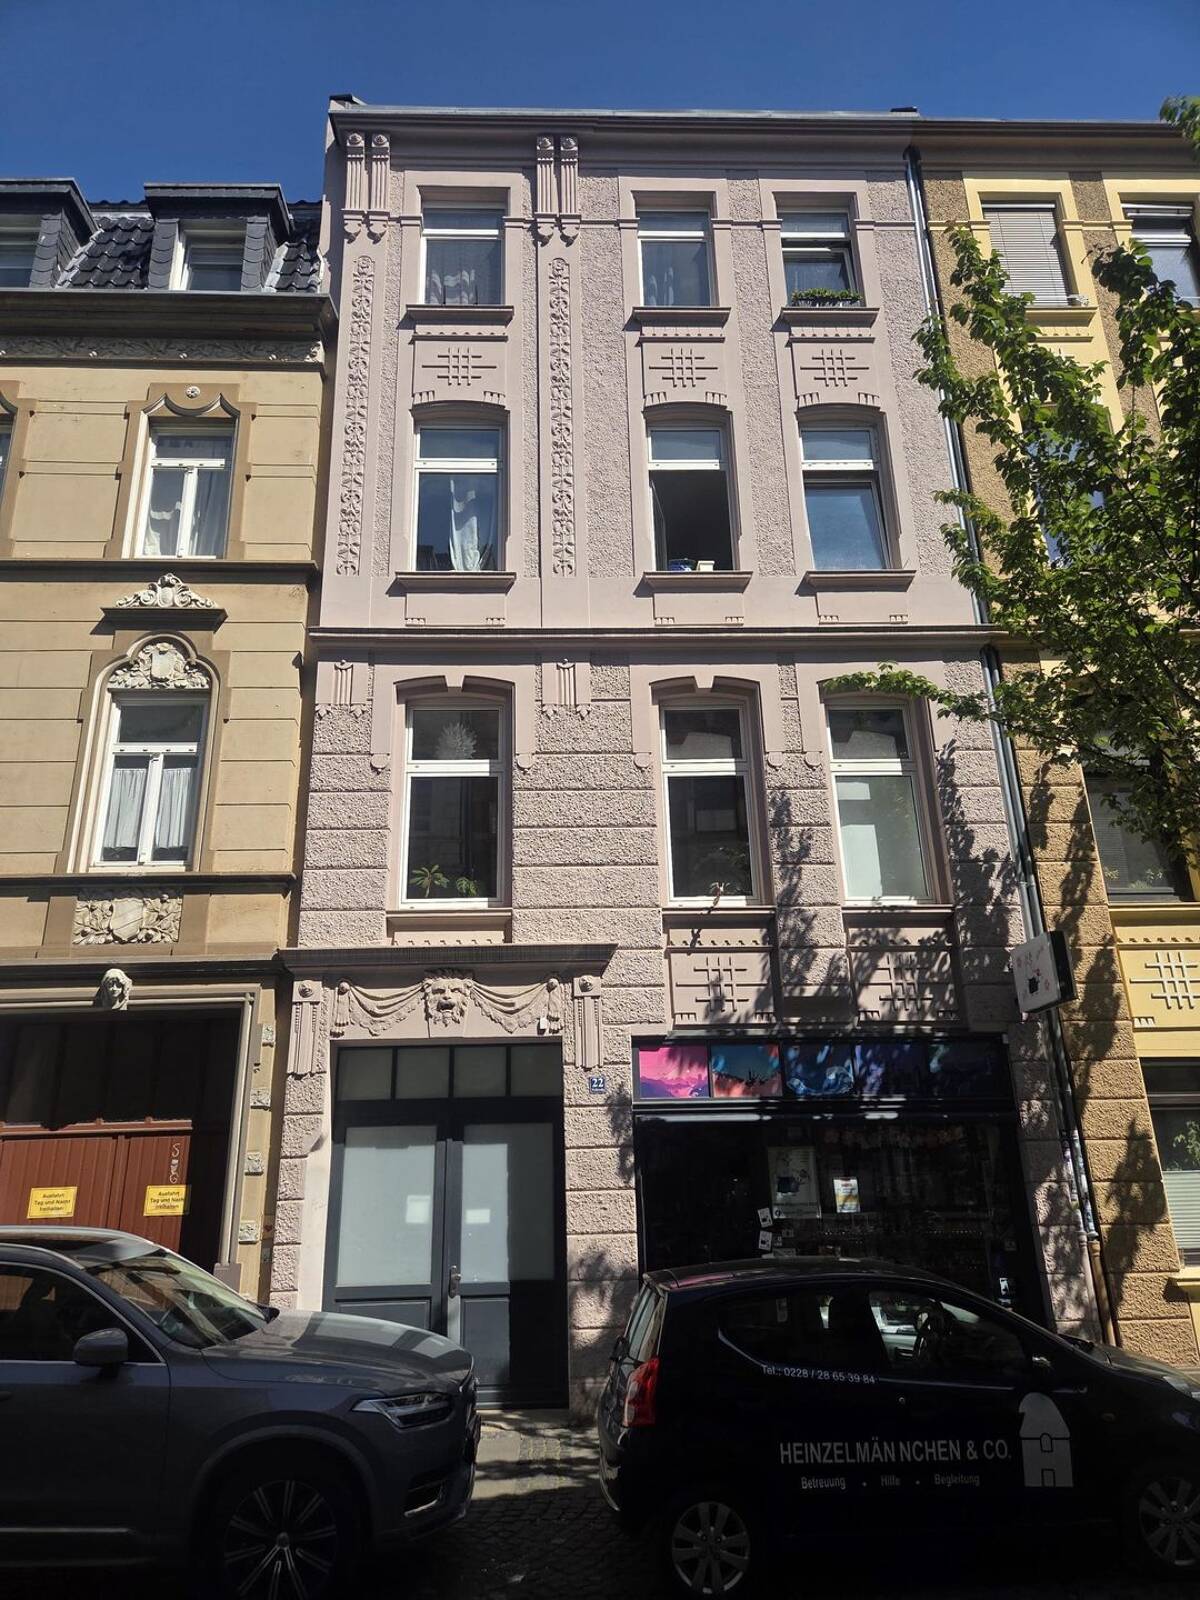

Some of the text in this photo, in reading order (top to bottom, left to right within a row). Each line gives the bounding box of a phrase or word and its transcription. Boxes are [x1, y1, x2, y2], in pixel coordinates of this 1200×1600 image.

[592, 1078, 604, 1088] 22
[762, 1364, 782, 1376] Tel.:
[783, 1367, 809, 1378] 0228
[817, 1369, 830, 1380] 28
[832, 1371, 846, 1381] 65
[847, 1372, 861, 1383] 39
[863, 1374, 875, 1384] 84
[966, 1440, 979, 1460] &
[982, 1439, 1012, 1460] CO.
[800, 1472, 980, 1490] Betreuung Hilfe Begleitung
